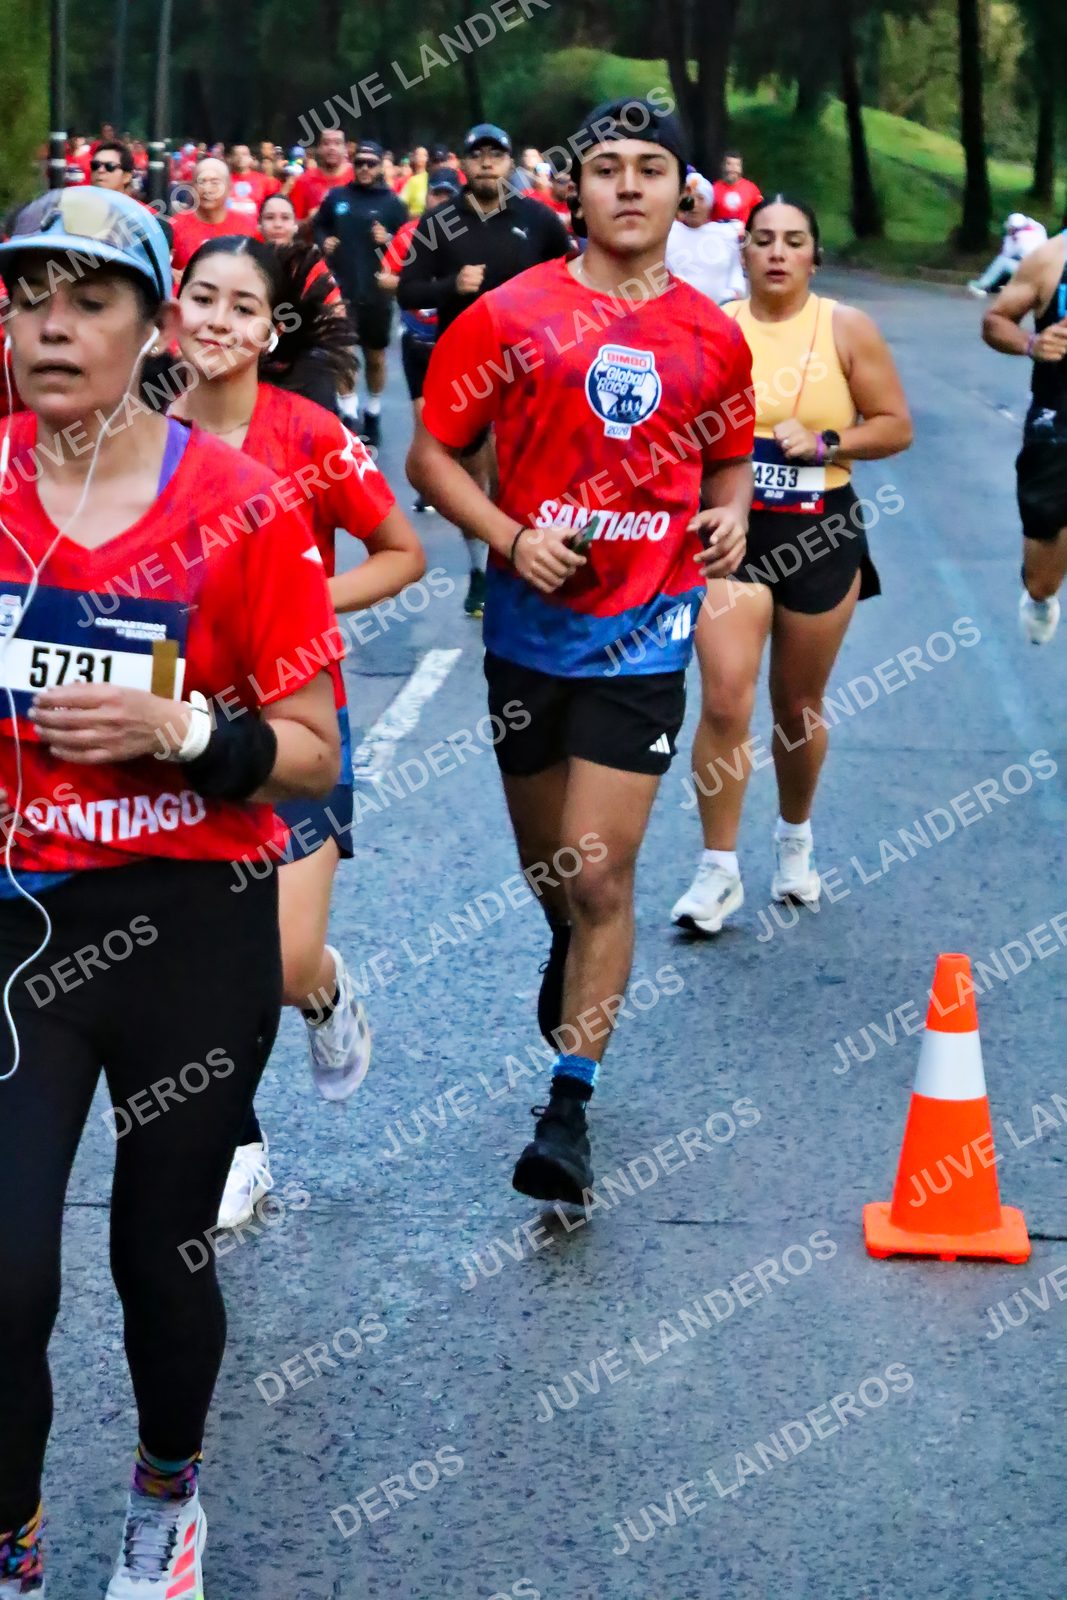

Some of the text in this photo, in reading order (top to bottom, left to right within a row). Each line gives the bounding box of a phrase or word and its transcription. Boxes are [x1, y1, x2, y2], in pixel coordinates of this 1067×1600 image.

[596, 377, 629, 396] Race
[606, 366, 646, 386] Global
[755, 465, 799, 488] 4253
[535, 500, 670, 541] SANTIAGO
[29, 646, 113, 688] 5731
